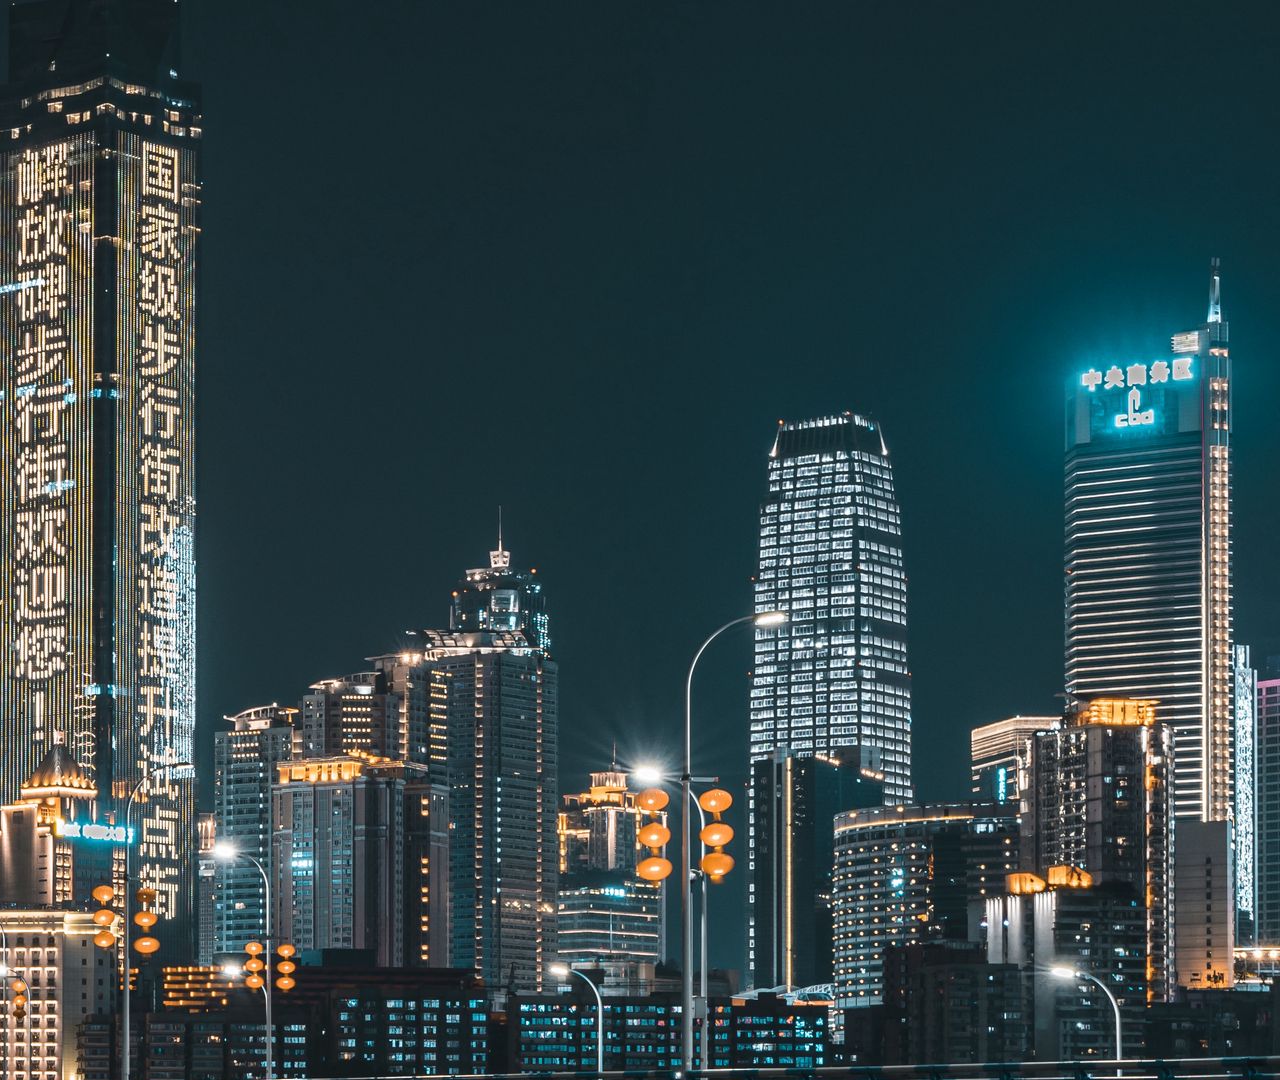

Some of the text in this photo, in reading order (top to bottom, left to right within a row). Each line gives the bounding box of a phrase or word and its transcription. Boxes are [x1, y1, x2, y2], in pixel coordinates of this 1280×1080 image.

[1081, 357, 1194, 392] 中央商务区
